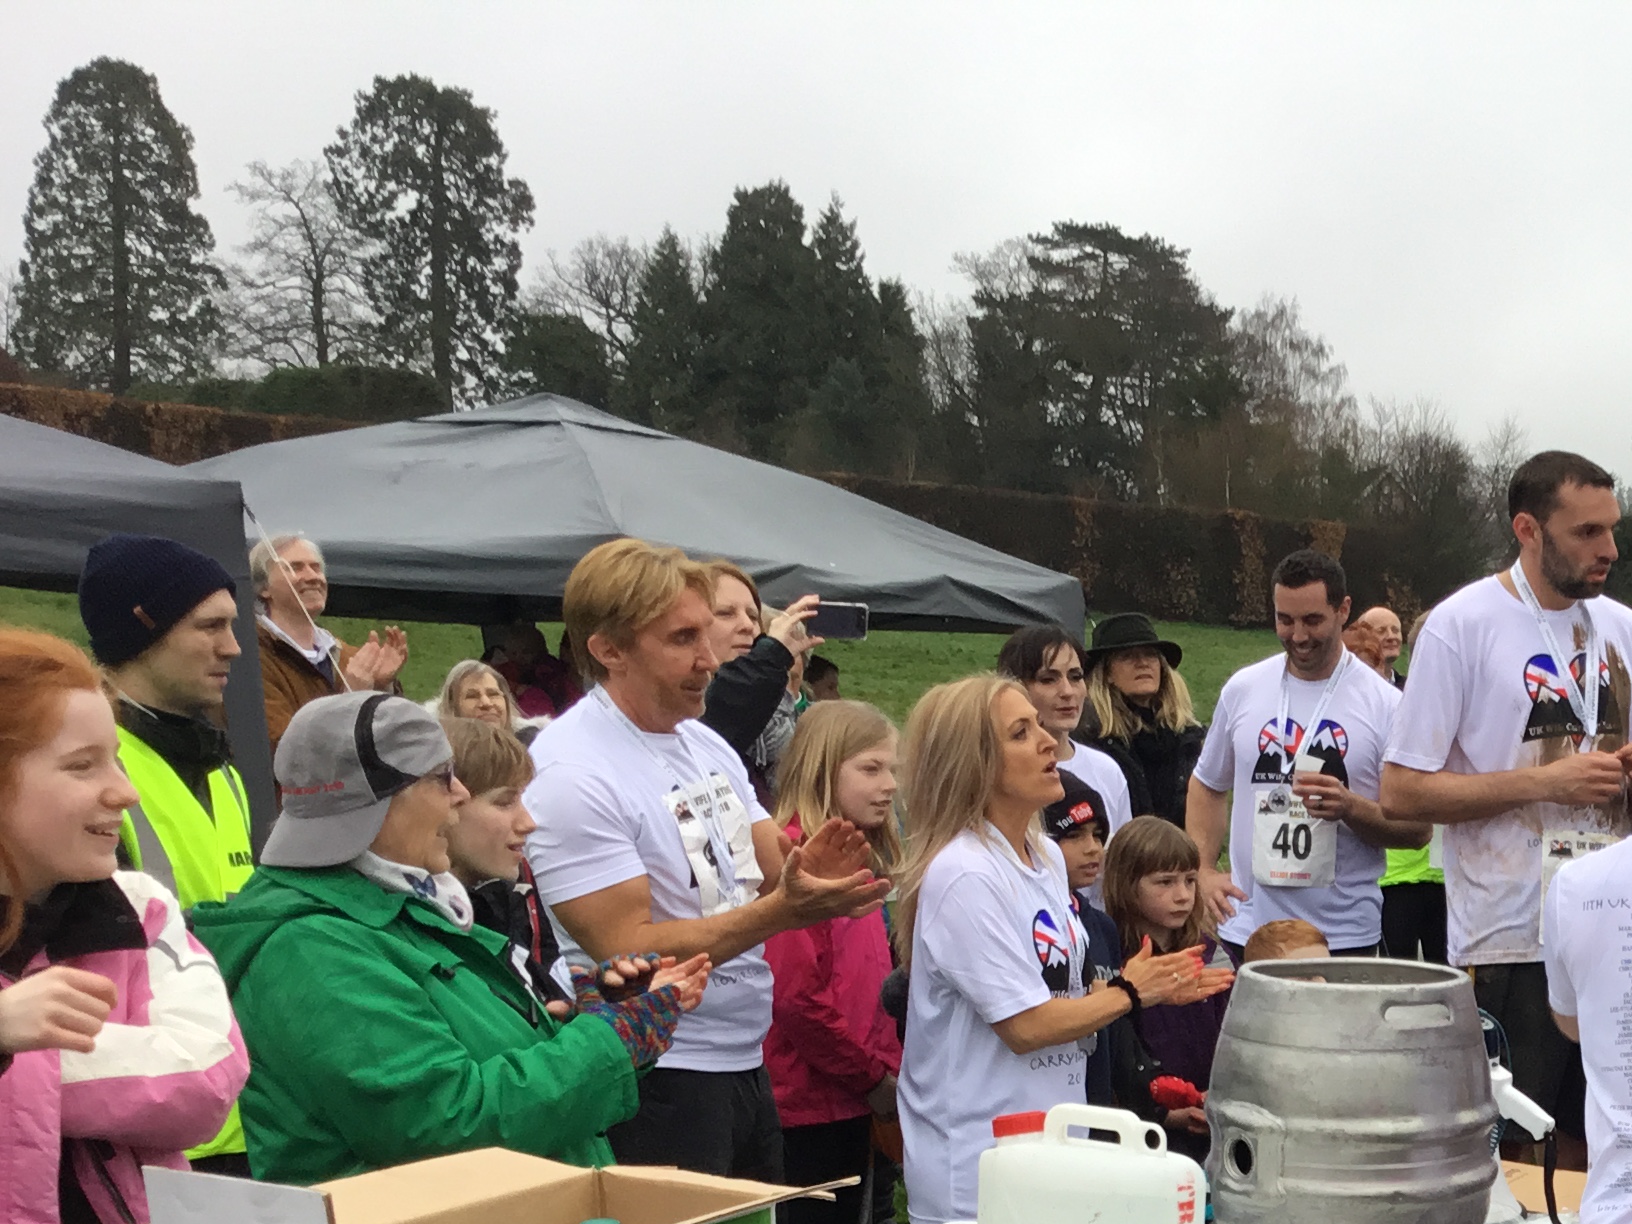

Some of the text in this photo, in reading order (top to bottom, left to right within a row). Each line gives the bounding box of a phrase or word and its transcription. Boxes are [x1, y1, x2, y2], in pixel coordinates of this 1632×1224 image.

[1529, 725, 1543, 736] UK
[1272, 823, 1312, 860] 40
[1576, 841, 1587, 850] UK
[1607, 898, 1631, 909] UK
